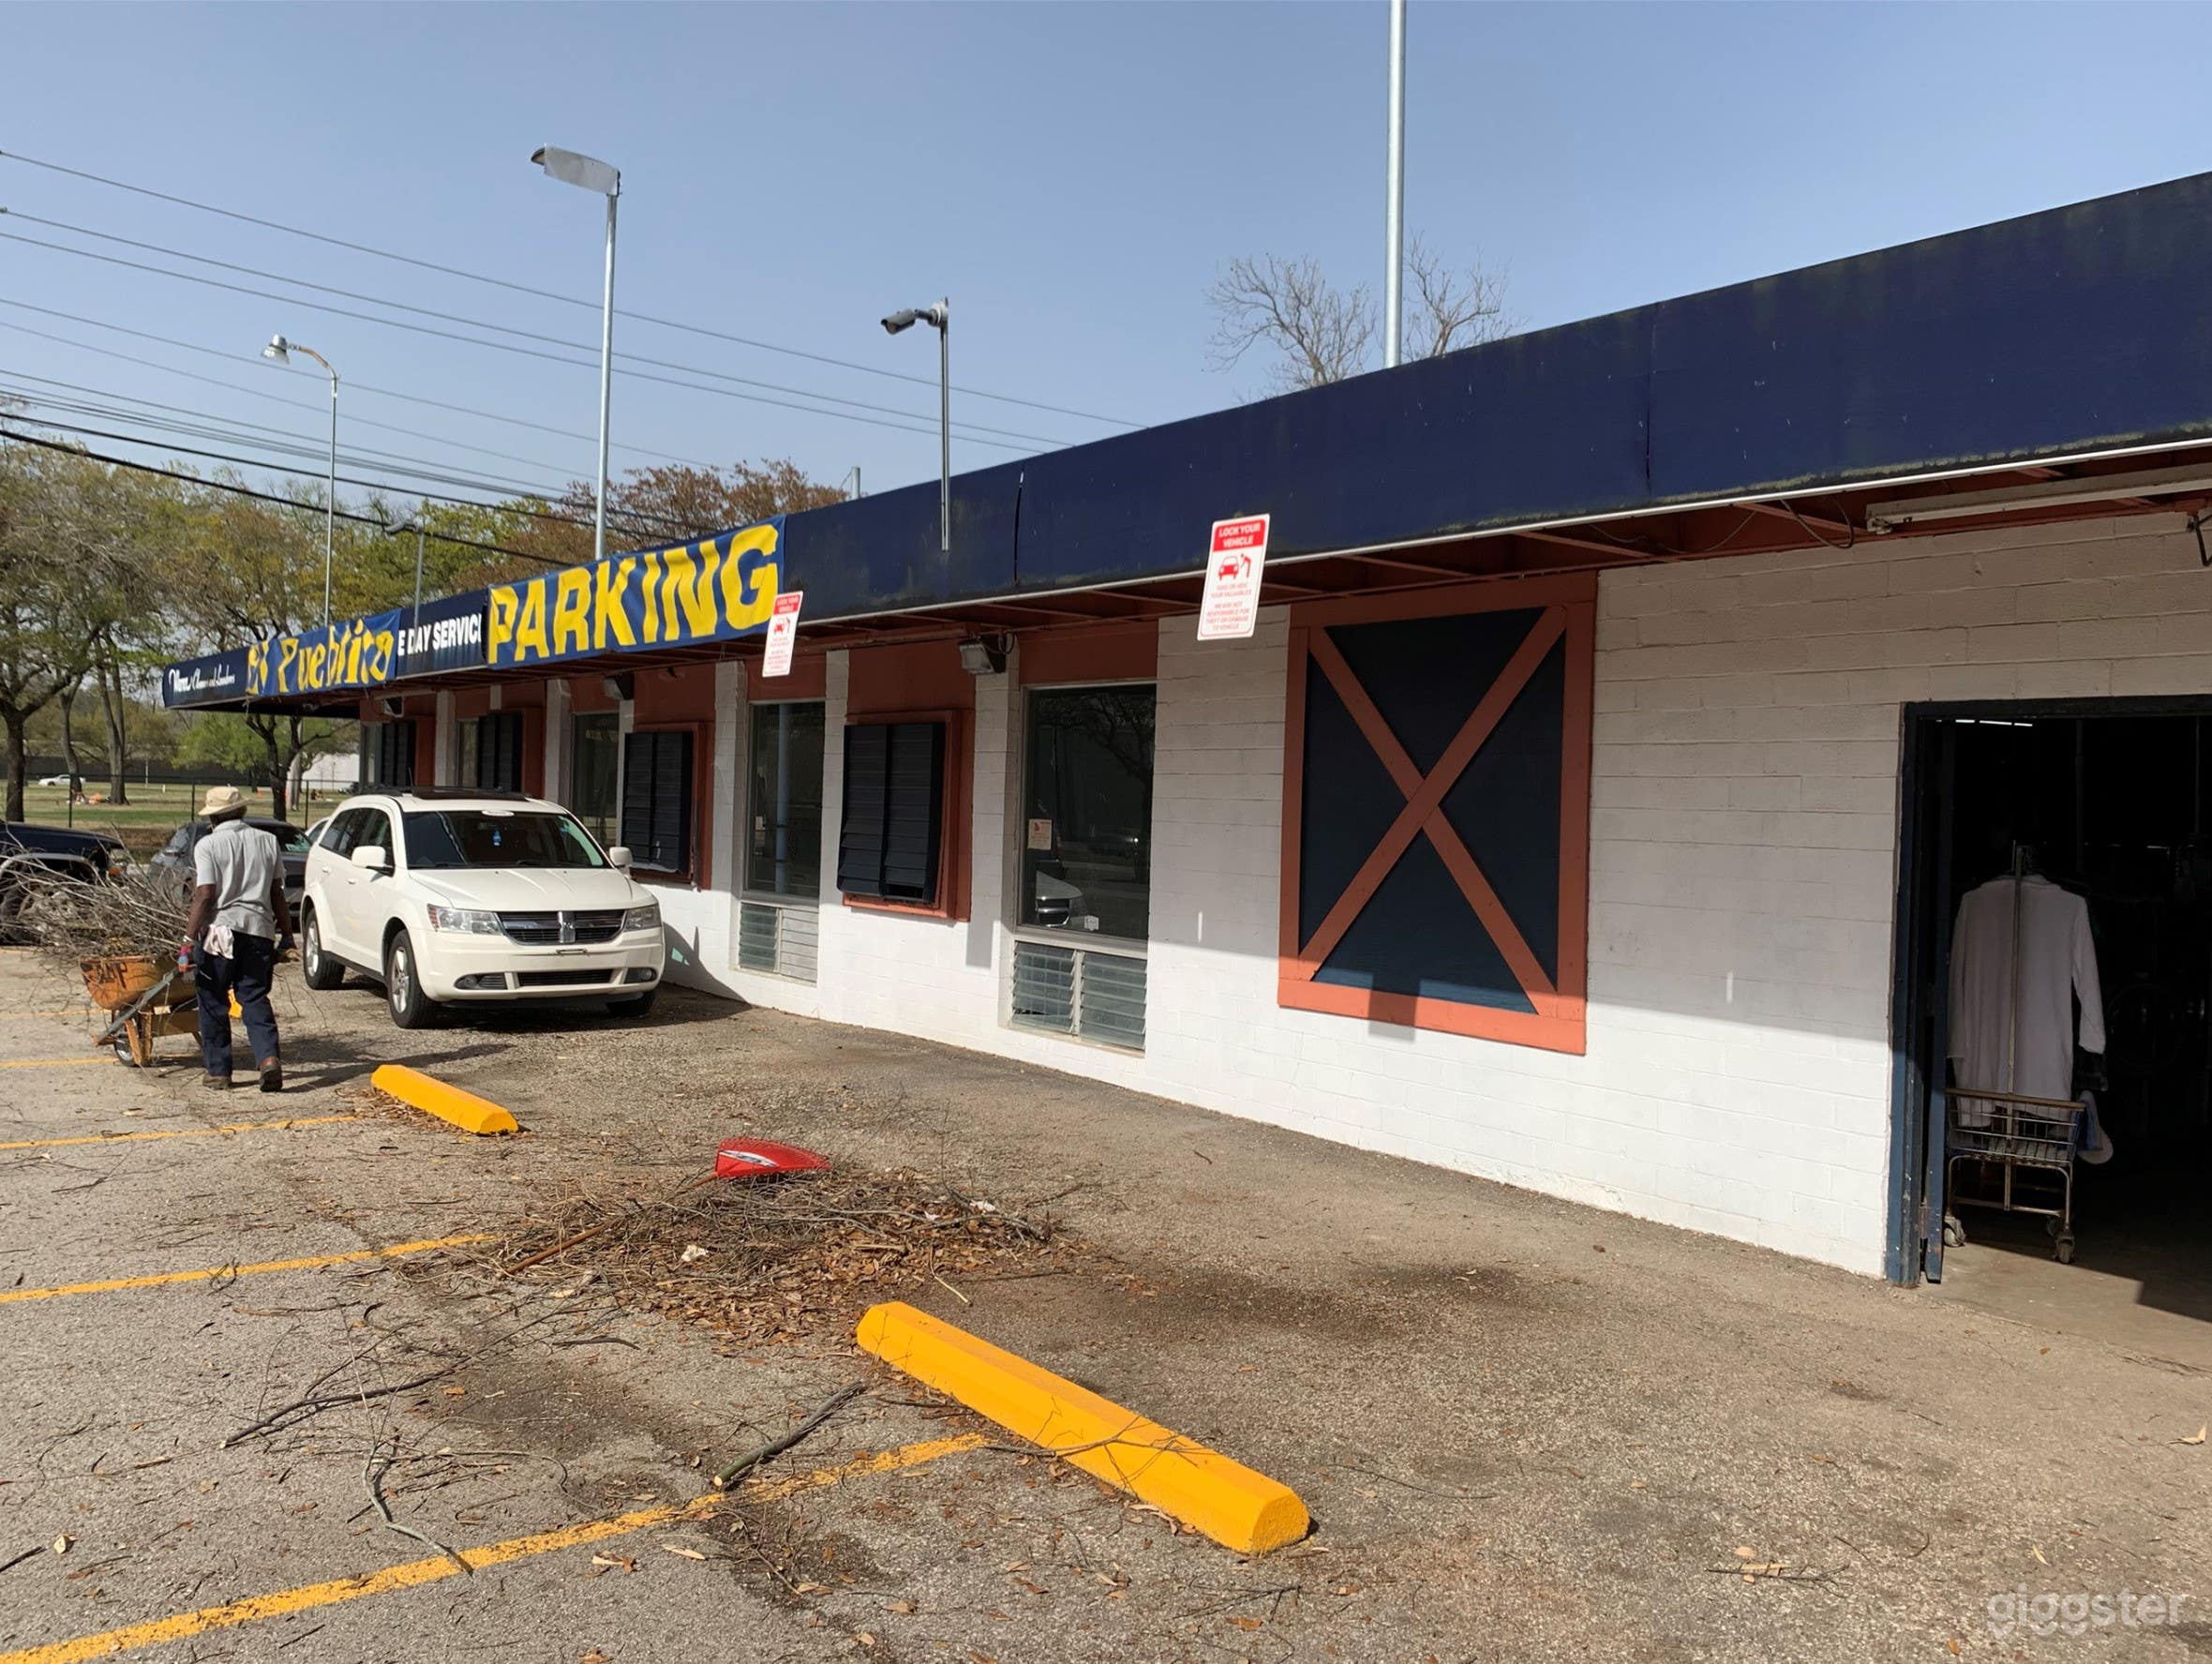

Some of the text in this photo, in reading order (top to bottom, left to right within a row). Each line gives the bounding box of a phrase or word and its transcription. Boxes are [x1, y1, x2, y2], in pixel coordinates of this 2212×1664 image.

[1218, 522, 1261, 537] LOCK YOUR
[1223, 535, 1254, 547] VEHICLE
[488, 524, 778, 664] PARKING
[407, 624, 431, 654] DAY
[278, 619, 394, 692] Pueblito
